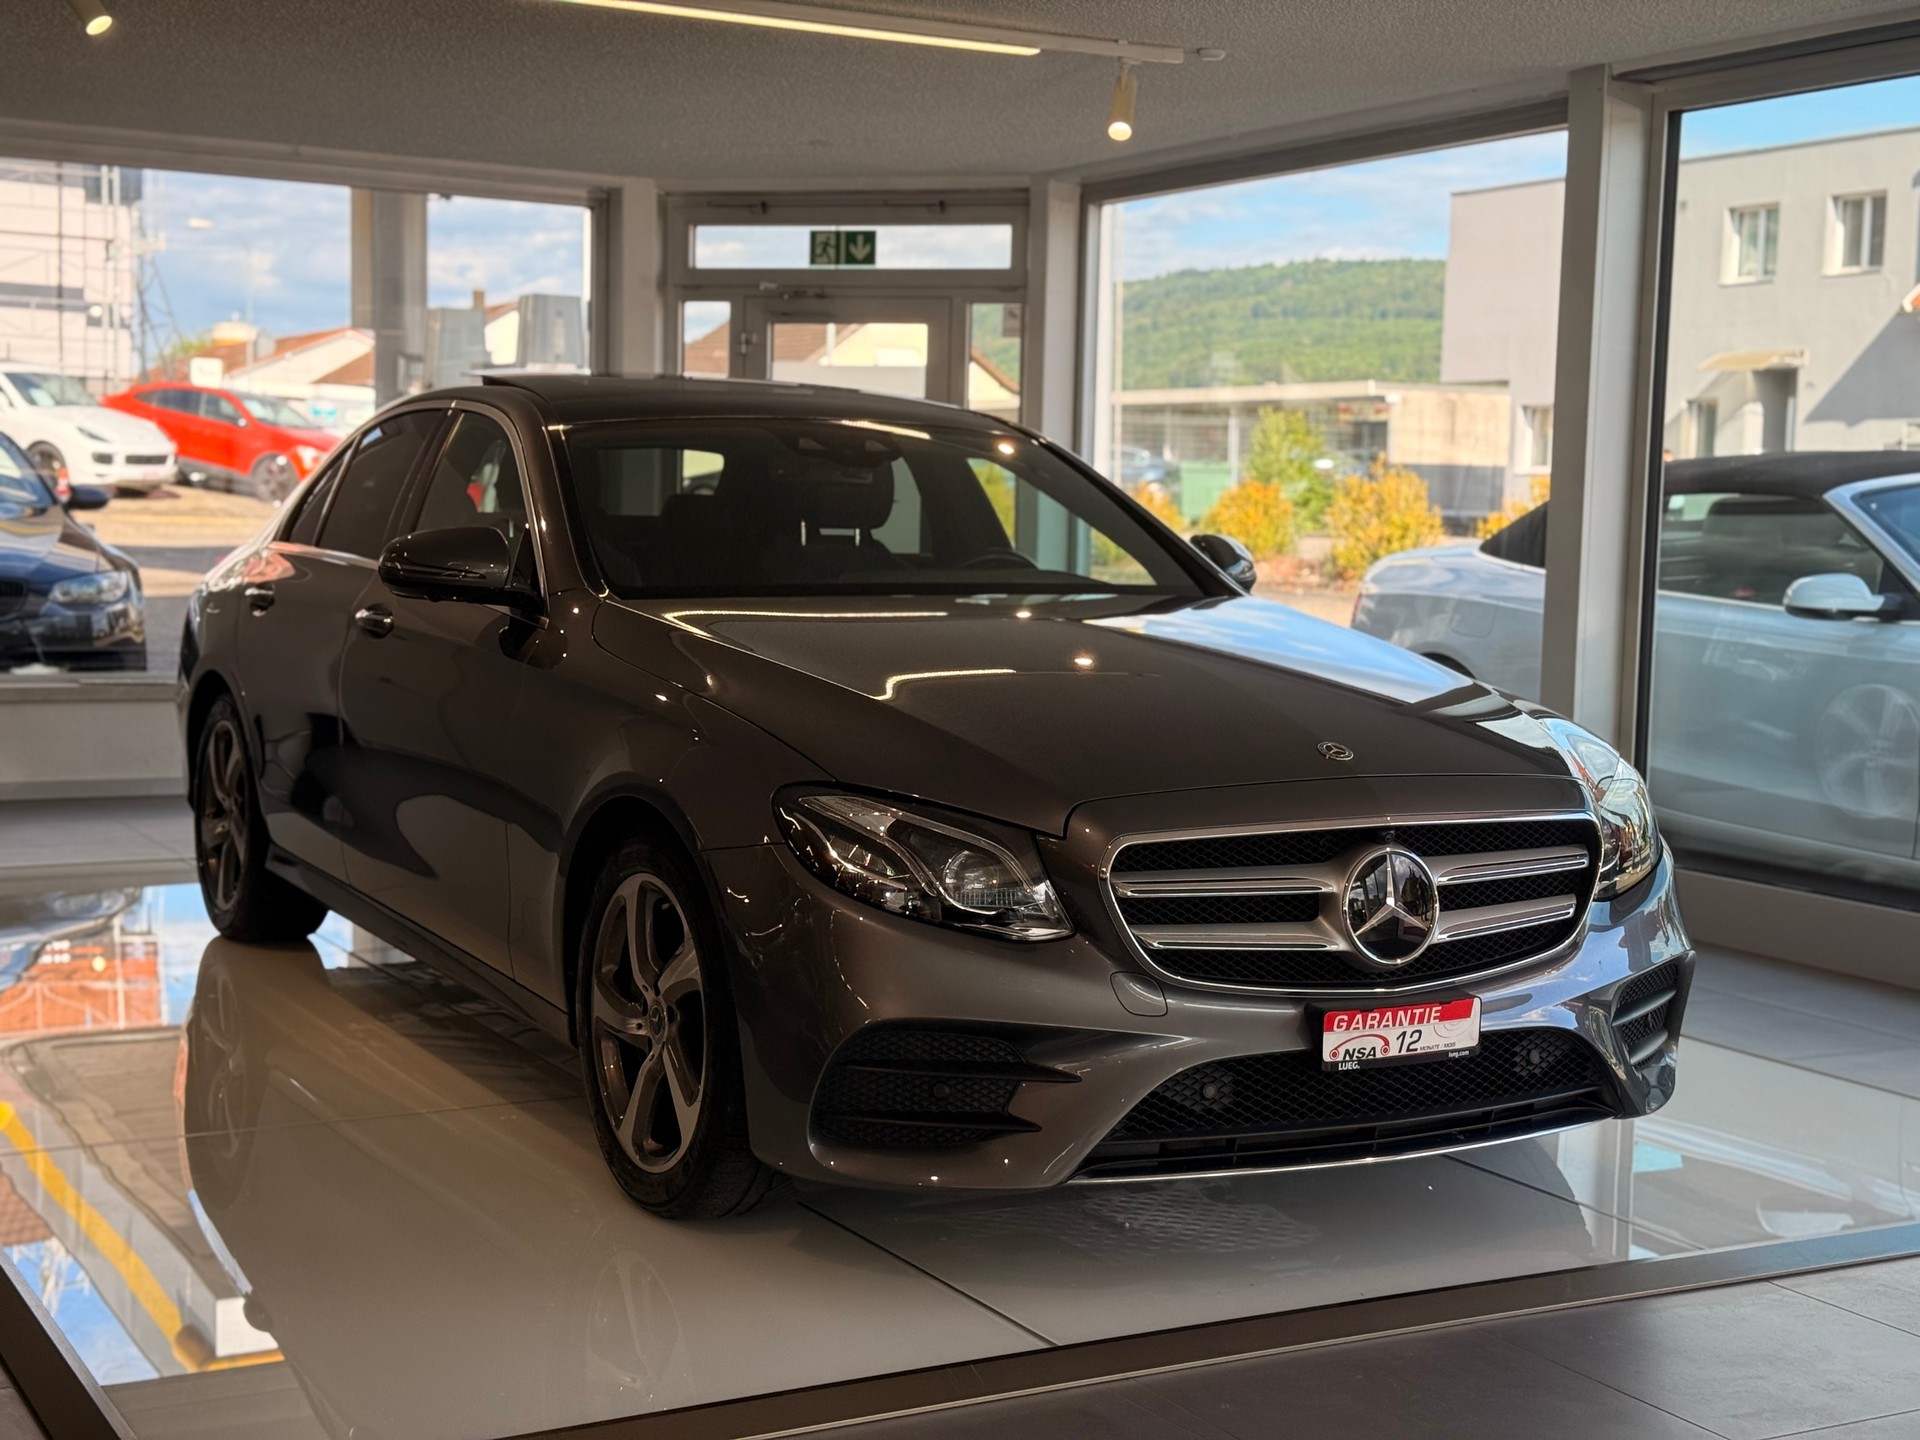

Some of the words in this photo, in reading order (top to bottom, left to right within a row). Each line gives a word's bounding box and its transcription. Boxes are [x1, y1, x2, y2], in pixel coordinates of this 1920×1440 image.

[1333, 1006, 1442, 1032] GARANTIE
[1396, 1029, 1423, 1053] 12
[1343, 1047, 1377, 1060] NSA
